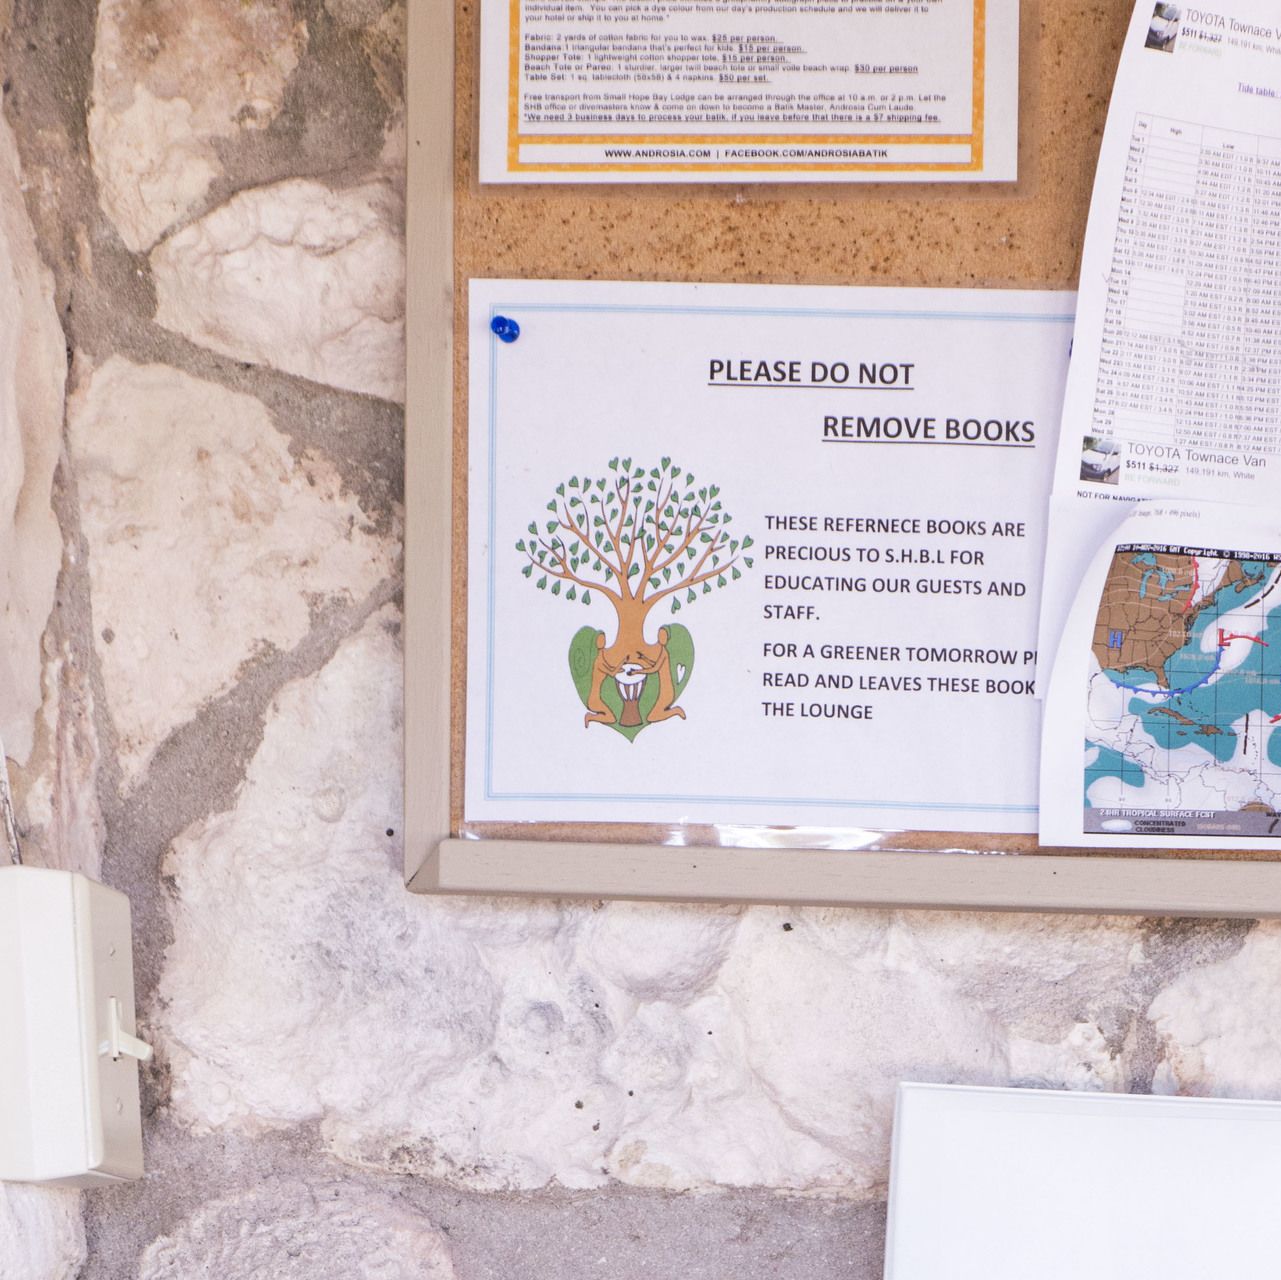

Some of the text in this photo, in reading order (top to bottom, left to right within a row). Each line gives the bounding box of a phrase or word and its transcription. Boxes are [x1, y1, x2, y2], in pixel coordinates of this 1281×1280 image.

[1181, 26, 1197, 39] $511
[1186, 8, 1226, 29] TOYOTA
[1229, 18, 1272, 38] Townace
[604, 148, 888, 159] WWW.ANDROSIA.COM FACEBOOK.COM/ANDROSIABATIK
[710, 360, 914, 384] PLEASE DO NOT
[823, 416, 1035, 442] REMOVE BOOKS
[1128, 442, 1266, 467] TOYOTA Townace Van
[1126, 460, 1146, 470] $511
[1234, 471, 1255, 480] White
[765, 516, 1025, 537] THESE REFERNECE BOOKS ARE
[765, 546, 984, 565] PRECIOUS TO S.H.B.L FOR
[765, 575, 1026, 596] EDUCATING OUR GUESTS AND
[764, 604, 820, 620] STAFF.
[764, 643, 797, 658] FOR
[803, 644, 814, 658] A
[821, 645, 900, 660] GREENER
[906, 648, 1018, 664] TOMORROW
[763, 673, 808, 688] READ
[815, 674, 853, 689] AND
[860, 676, 922, 691] LEAVES
[928, 678, 980, 692] THESE
[762, 702, 872, 720] THE LOUNGE
